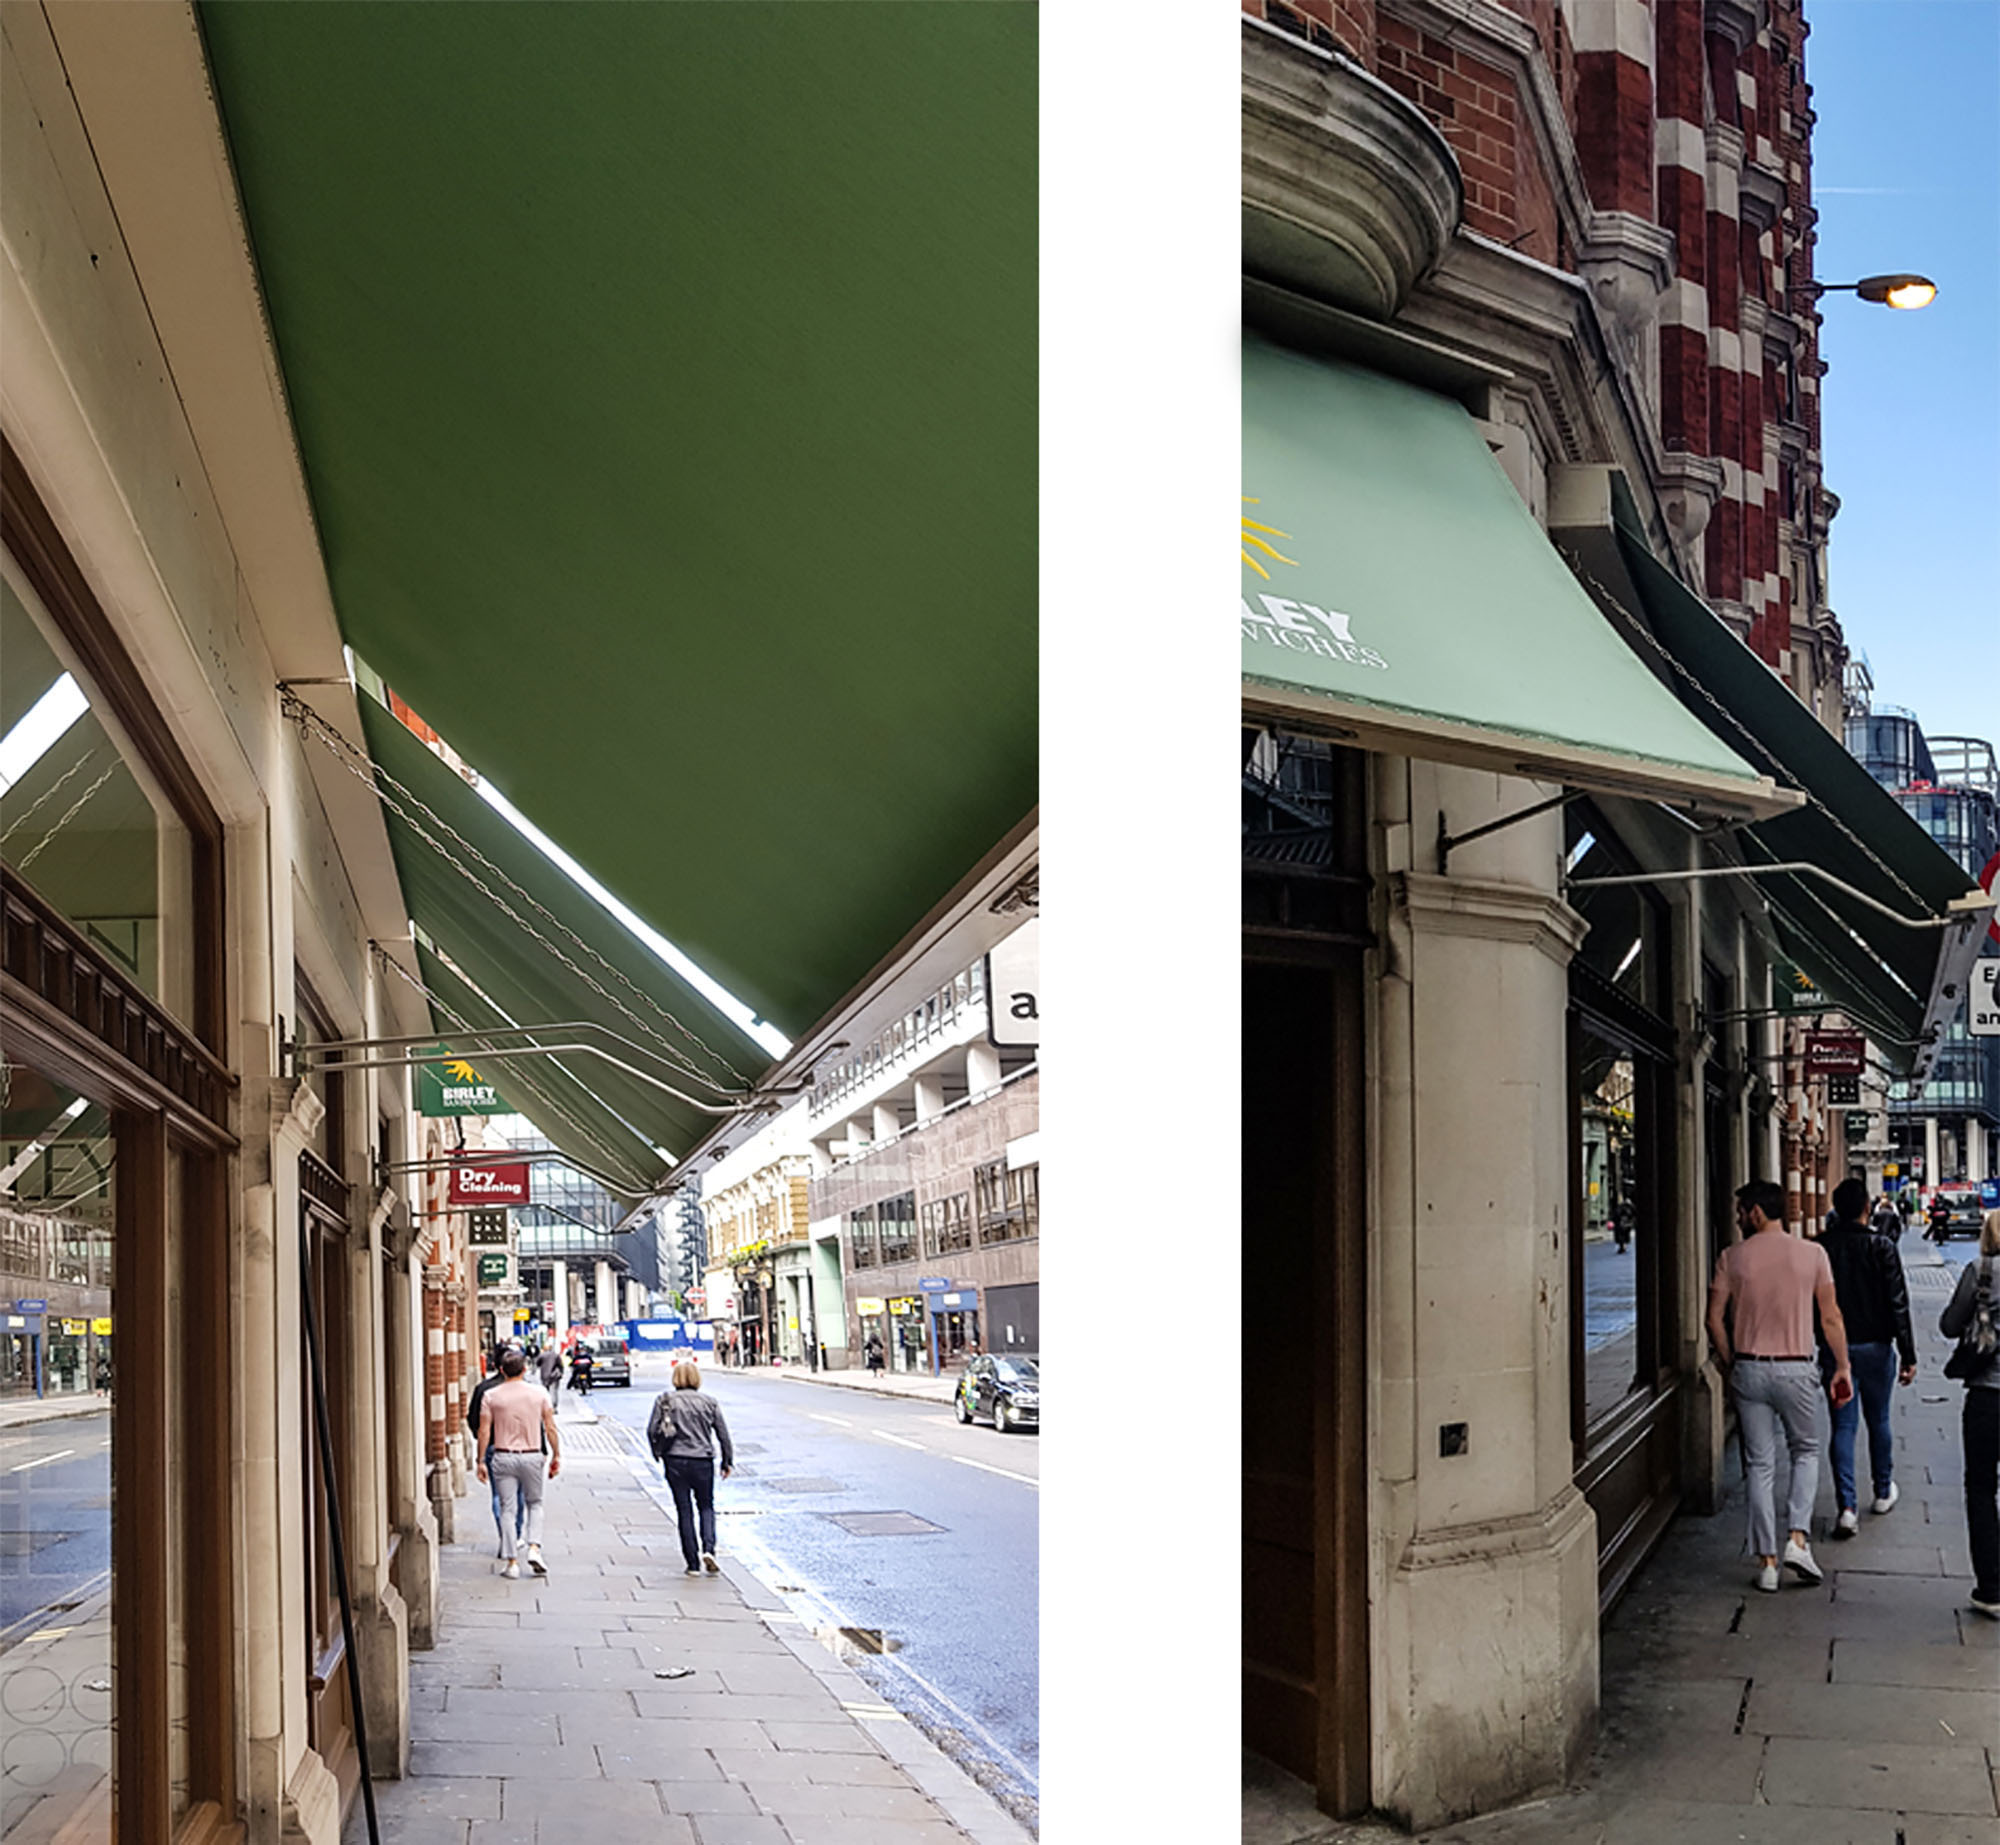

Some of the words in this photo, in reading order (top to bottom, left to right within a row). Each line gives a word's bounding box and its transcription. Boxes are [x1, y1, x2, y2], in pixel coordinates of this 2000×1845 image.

[442, 1086, 495, 1100] BIRLEY
[459, 1168, 496, 1185] Dry
[459, 1182, 522, 1195] Cleaning
